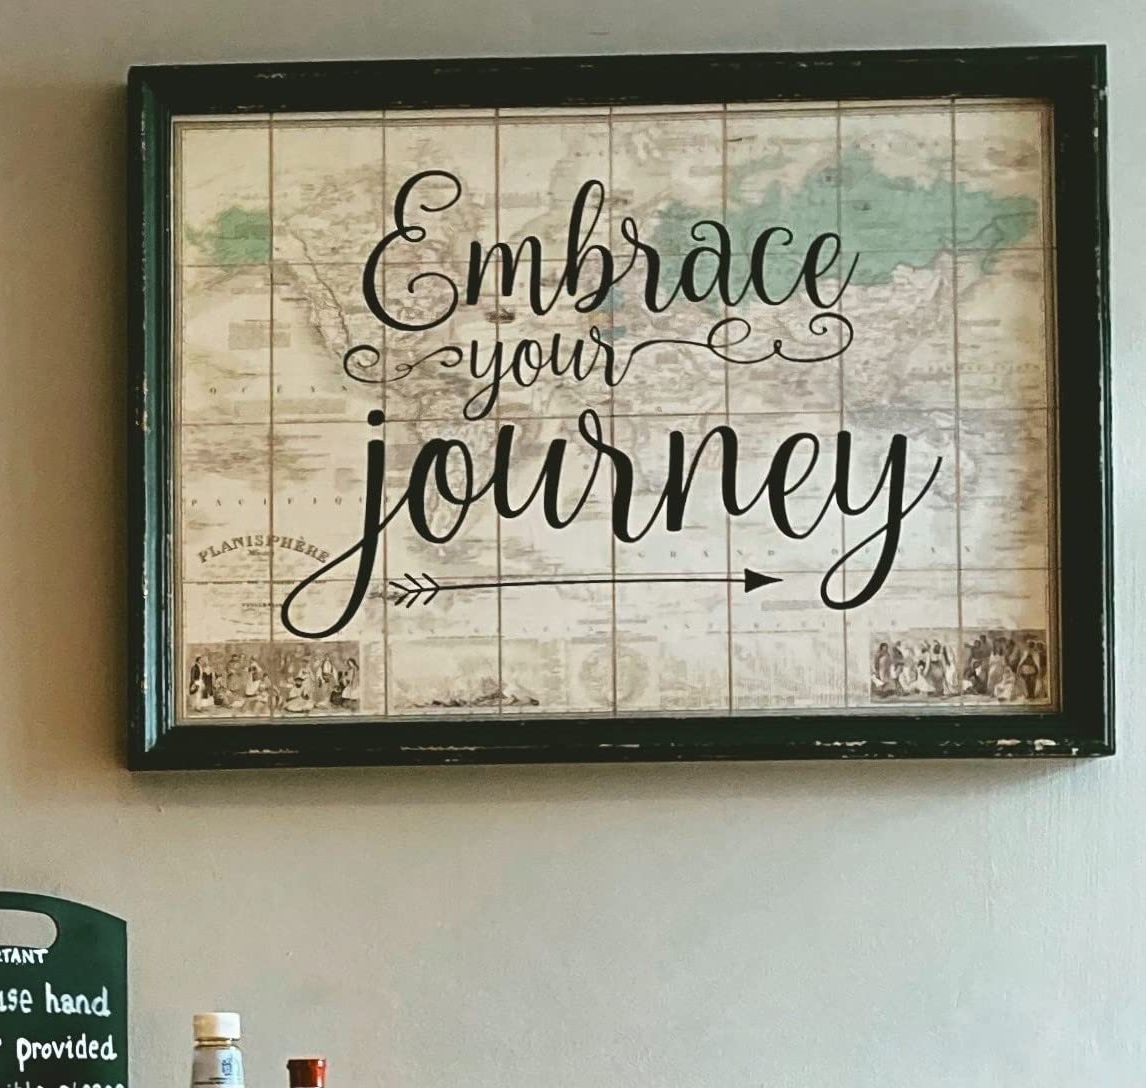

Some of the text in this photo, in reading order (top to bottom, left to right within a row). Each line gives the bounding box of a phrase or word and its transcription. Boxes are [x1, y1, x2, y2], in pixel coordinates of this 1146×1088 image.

[362, 170, 860, 331] Embrace
[281, 409, 943, 639] journey
[45, 981, 112, 1017] hand
[16, 1033, 118, 1072] provided
